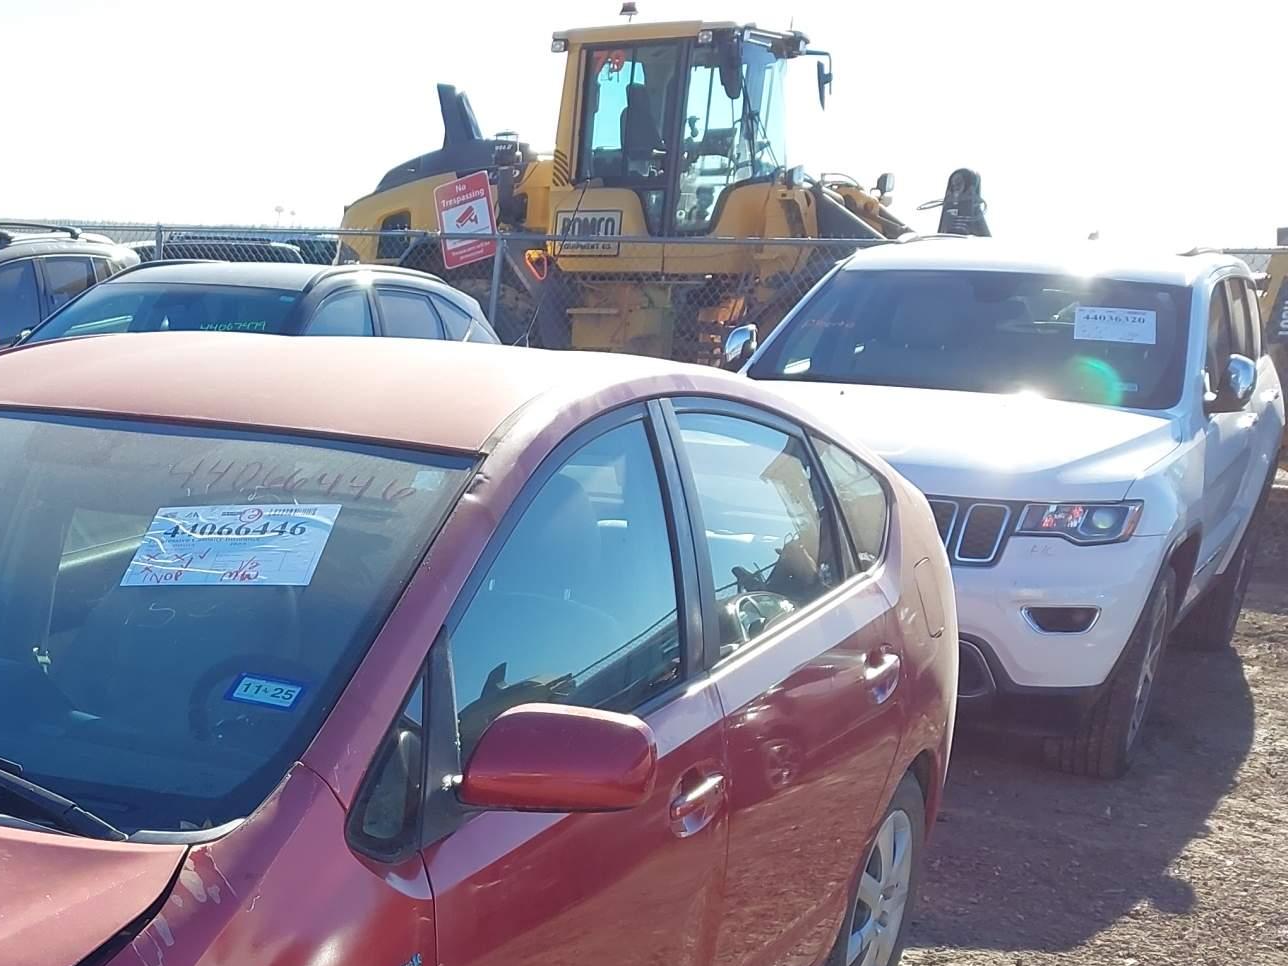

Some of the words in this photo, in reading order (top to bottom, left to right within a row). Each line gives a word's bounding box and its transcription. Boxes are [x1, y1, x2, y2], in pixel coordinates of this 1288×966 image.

[455, 183, 467, 193] No
[440, 188, 485, 208] Trespassing
[168, 458, 417, 501] 44066446
[163, 520, 307, 538] 44066446
